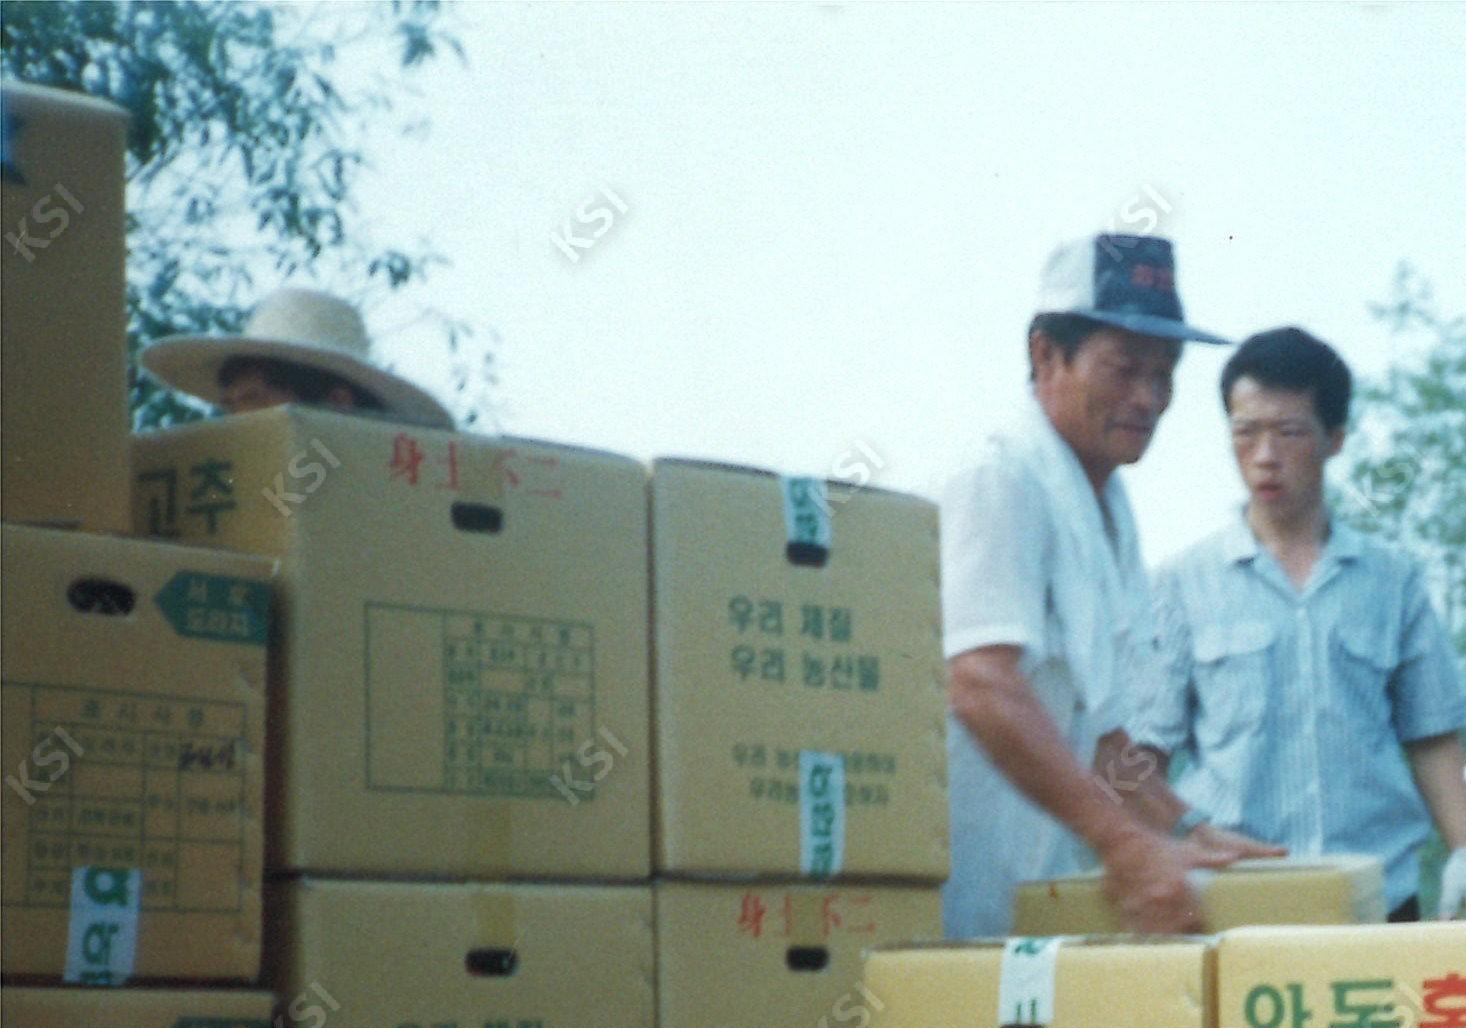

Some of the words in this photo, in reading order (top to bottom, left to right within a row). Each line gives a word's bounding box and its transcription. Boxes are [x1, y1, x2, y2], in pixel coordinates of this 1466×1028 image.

[728, 594, 784, 636] 우리
[730, 645, 786, 694] 우리
[802, 651, 882, 702] 농산물
